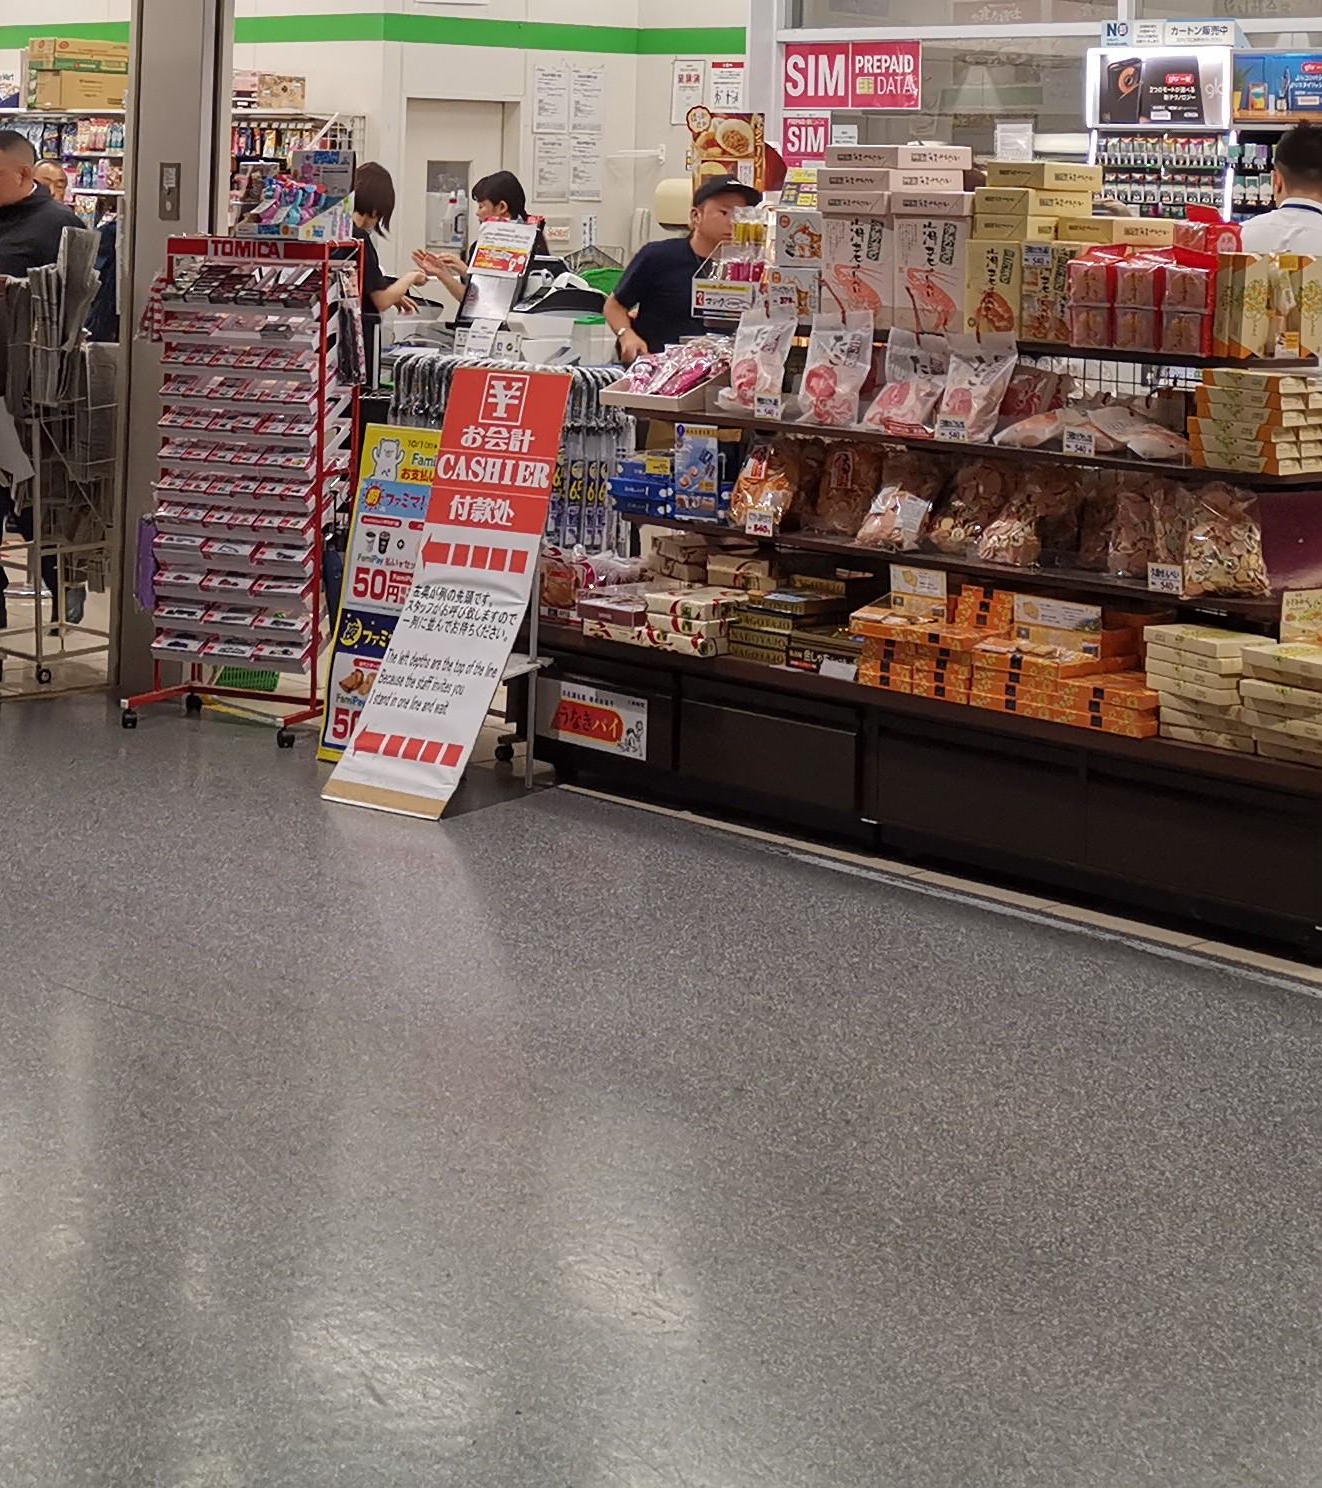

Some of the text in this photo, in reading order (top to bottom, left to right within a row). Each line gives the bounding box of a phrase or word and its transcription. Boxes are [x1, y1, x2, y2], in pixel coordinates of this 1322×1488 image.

[785, 54, 845, 97] SIM
[855, 55, 914, 74] PREPAID
[877, 77, 916, 95] DATA
[787, 126, 825, 153] SIM
[210, 239, 281, 259] TOMICA
[460, 425, 535, 453] お会計
[437, 453, 550, 489] CASHIER
[449, 494, 515, 526] 付款处
[413, 585, 493, 608] 左奥が列の先頭です。
[343, 618, 393, 648] 夜ファミ
[385, 648, 397, 662] The
[378, 669, 403, 687] Because
[404, 673, 415, 688] the
